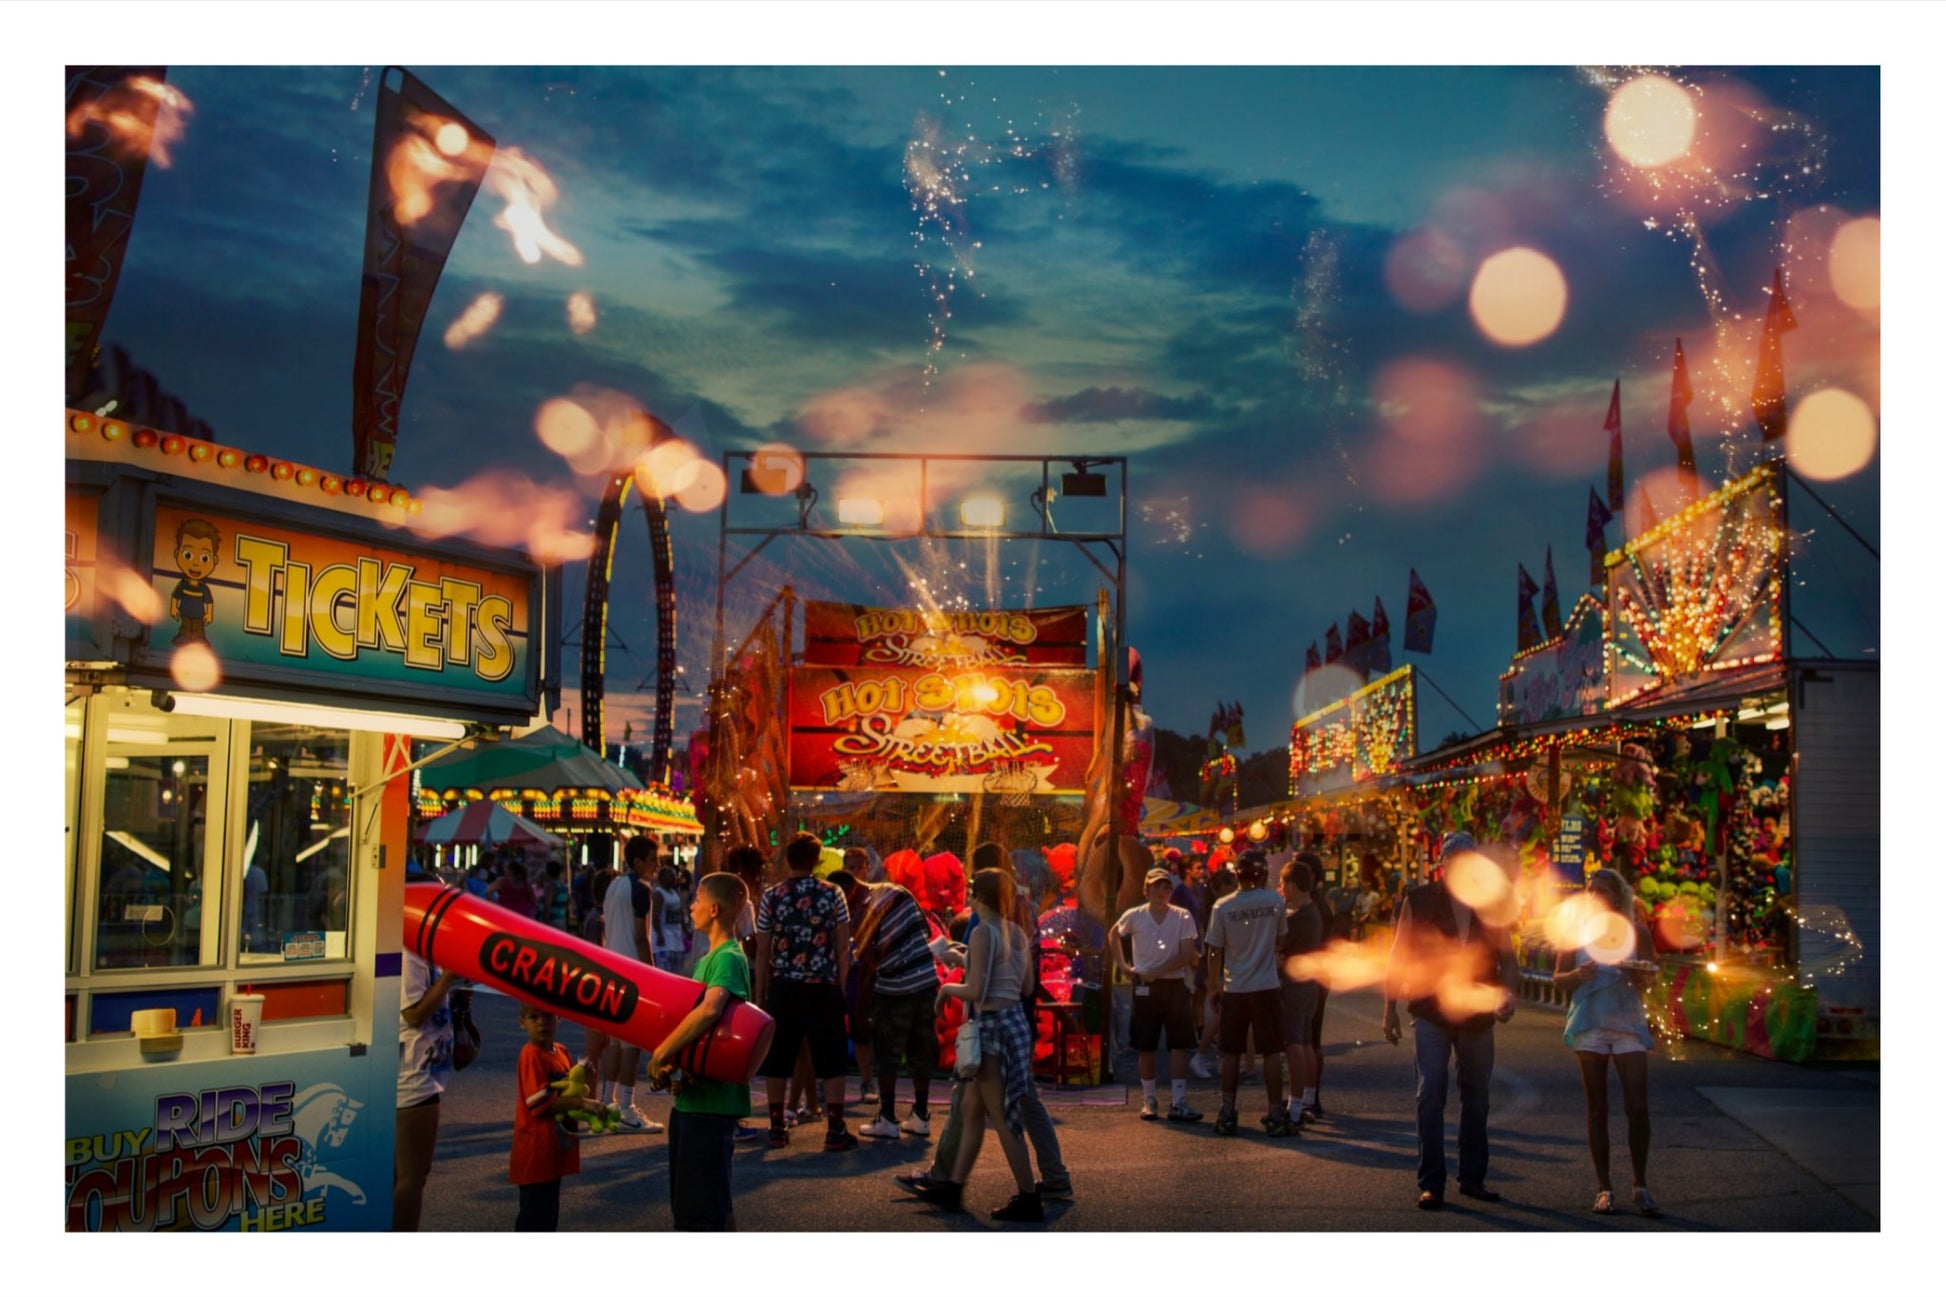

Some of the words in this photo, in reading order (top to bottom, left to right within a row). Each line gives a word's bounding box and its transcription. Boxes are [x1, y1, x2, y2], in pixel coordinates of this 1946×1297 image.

[235, 534, 514, 681] TICKETS
[856, 609, 918, 642] HOT
[820, 676, 907, 725] HOT
[915, 673, 1066, 727] SHOTS
[834, 713, 1053, 767] STREETBALL
[490, 938, 628, 1017] CRAYON
[233, 1008, 242, 1048] BURGER
[242, 1023, 251, 1048] KING
[65, 1127, 151, 1165] BUY
[154, 1080, 295, 1154] RIDE
[65, 1136, 303, 1232] OUPONS
[240, 1196, 325, 1232] HERE
